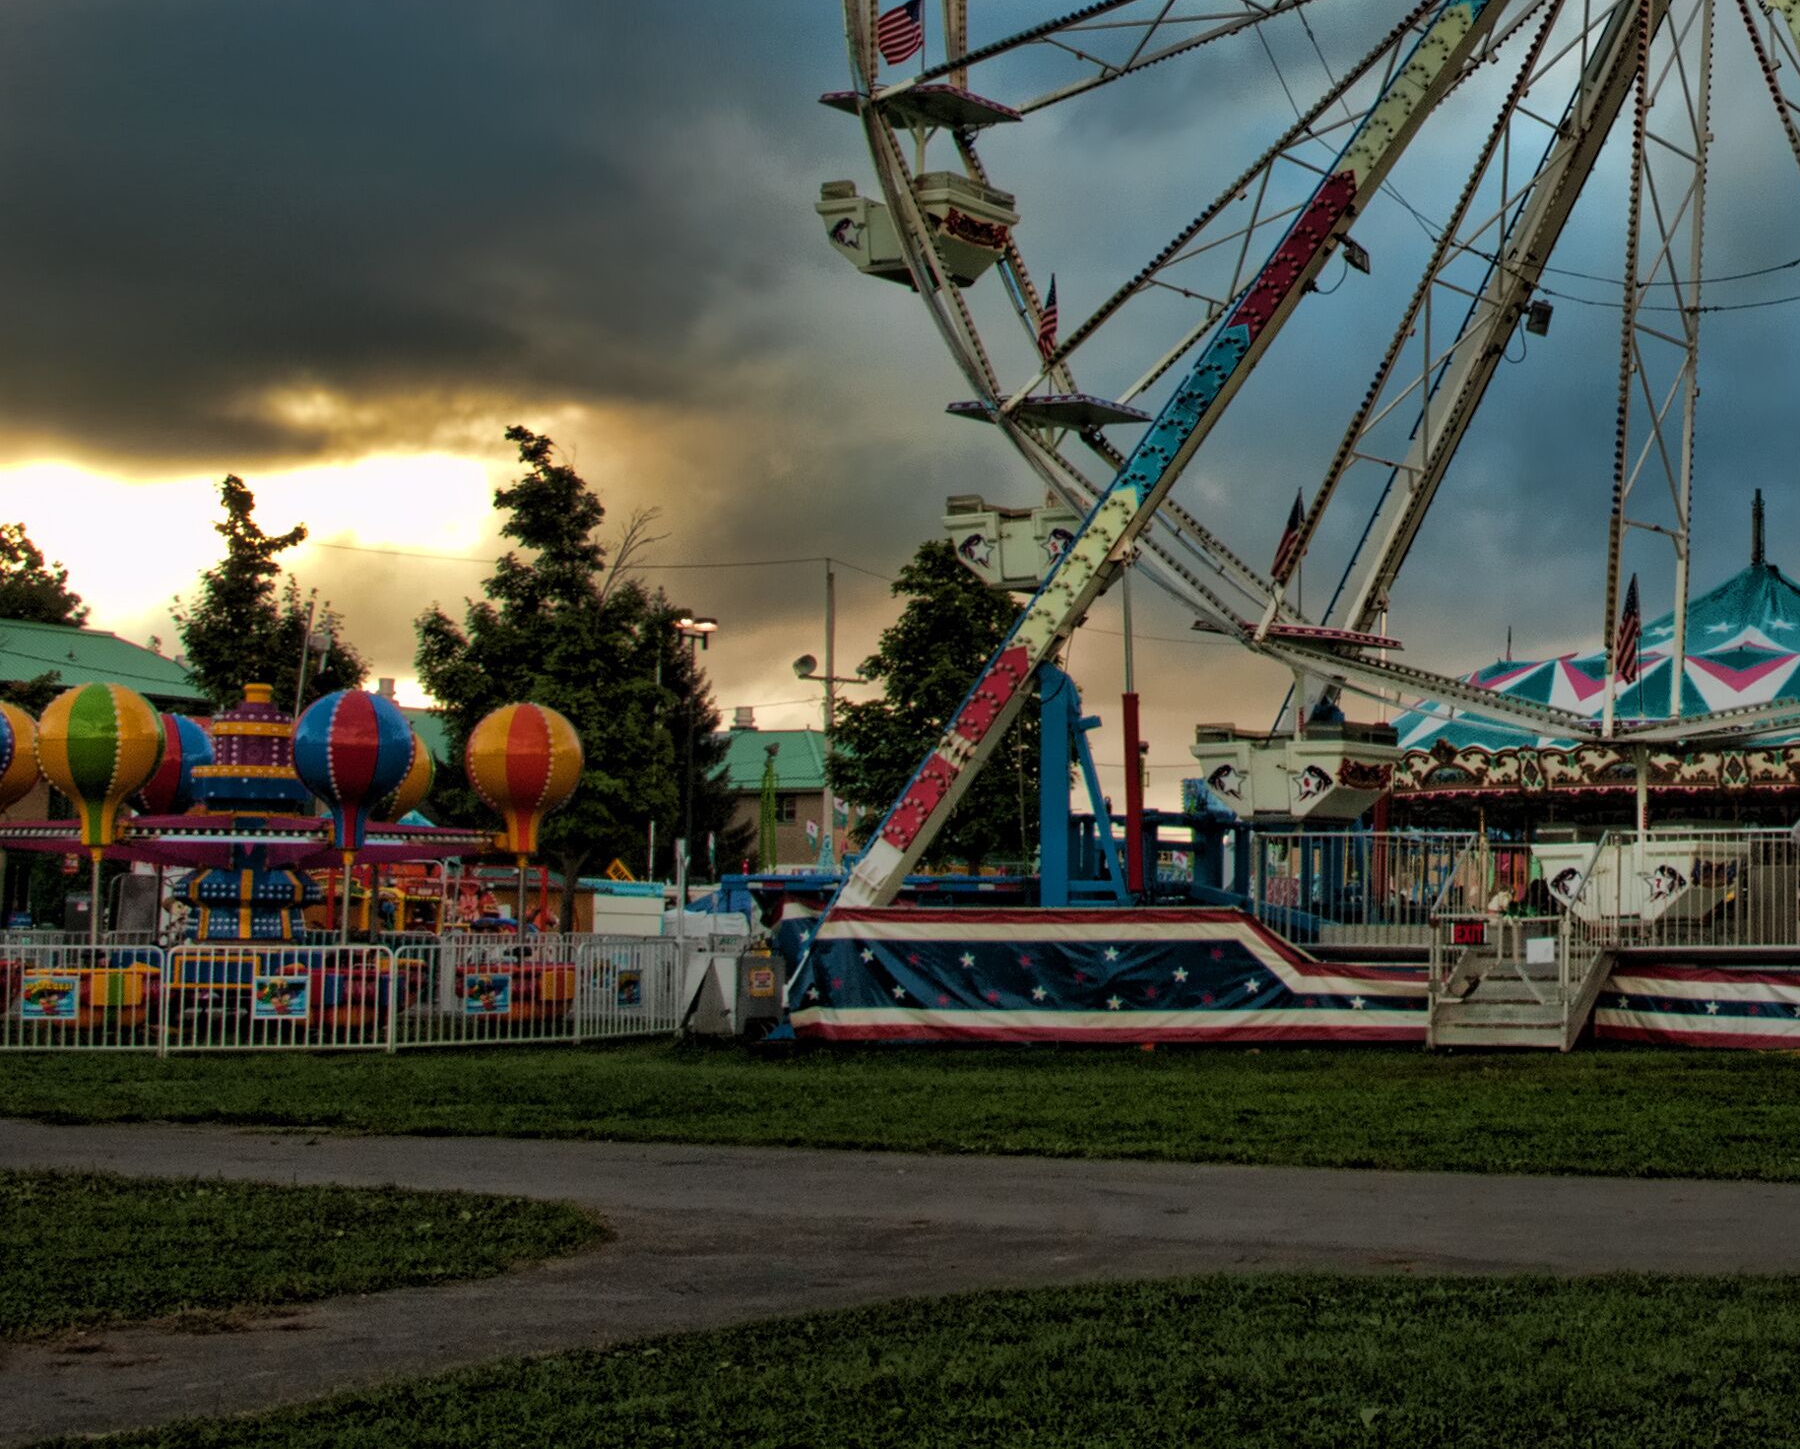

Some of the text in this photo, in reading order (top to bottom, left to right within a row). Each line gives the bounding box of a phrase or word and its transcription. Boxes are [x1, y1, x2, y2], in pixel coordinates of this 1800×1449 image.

[1303, 778, 1310, 788] 6
[1654, 877, 1664, 889] 7
[1455, 924, 1483, 944] EXIT
